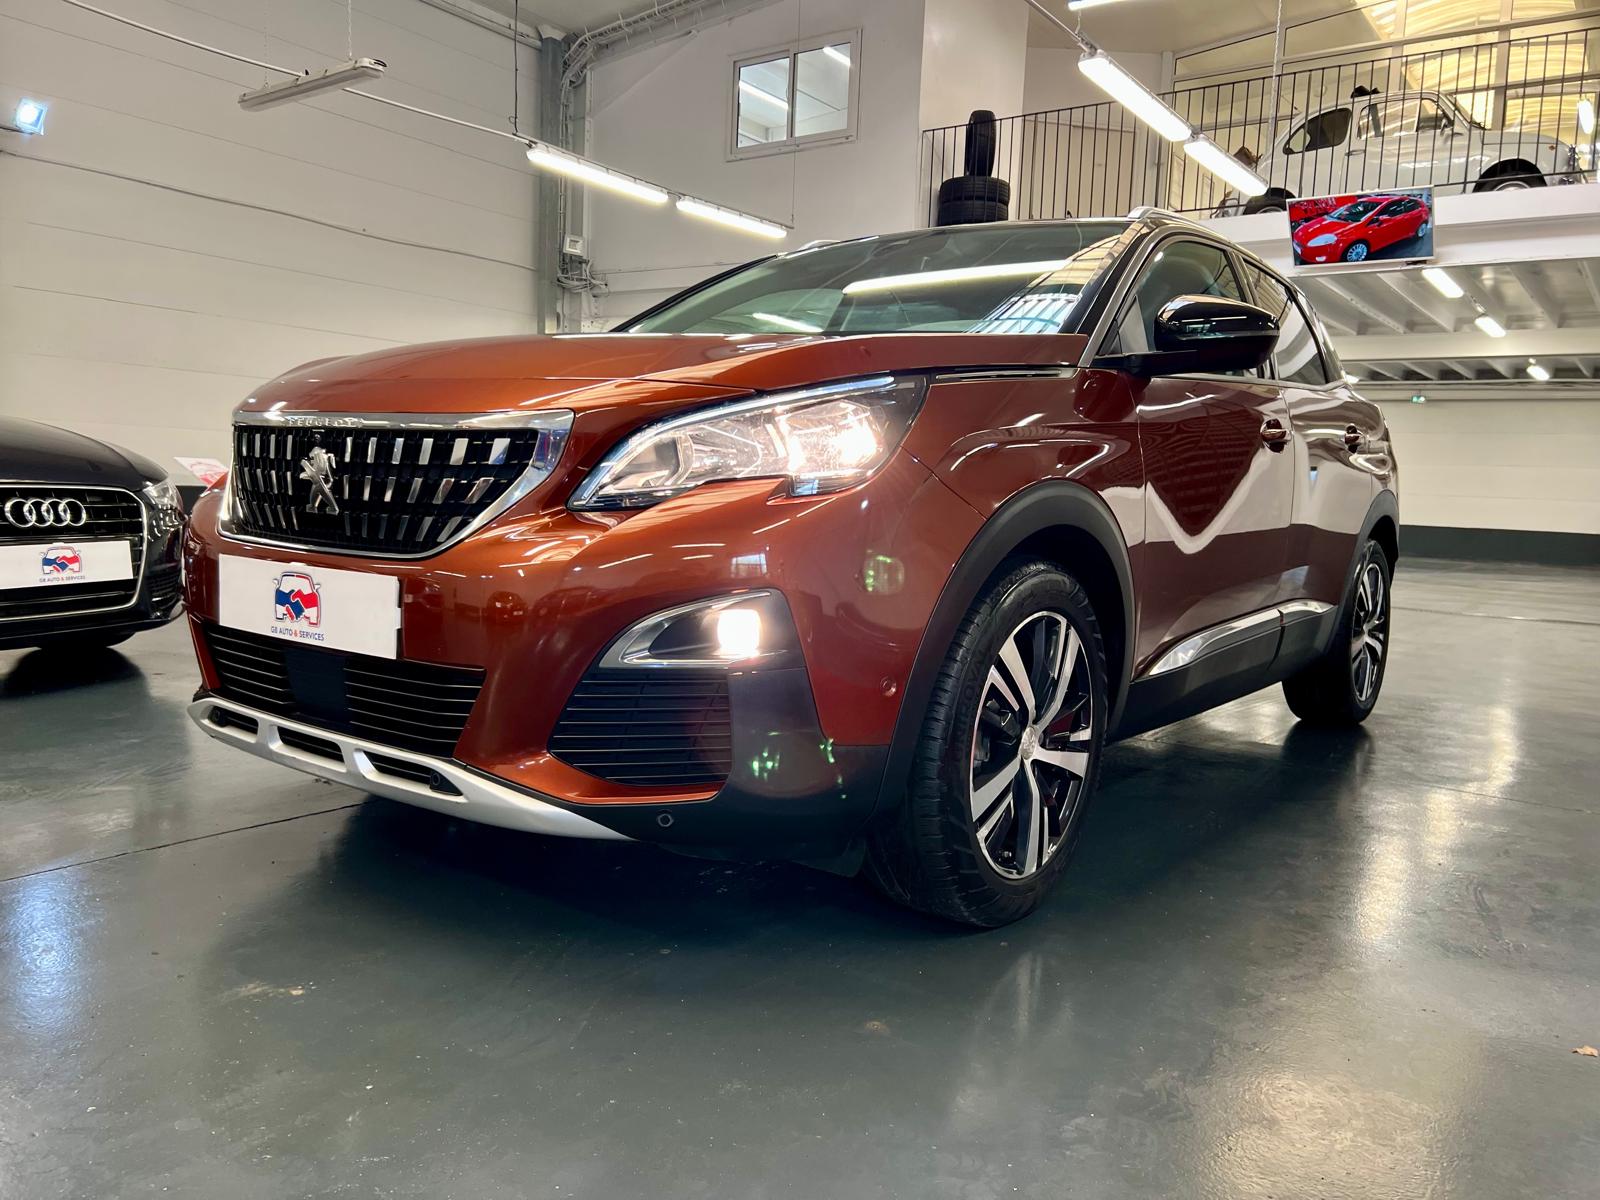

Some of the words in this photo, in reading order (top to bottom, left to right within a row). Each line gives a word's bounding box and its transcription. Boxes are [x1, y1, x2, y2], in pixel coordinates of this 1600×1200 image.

[288, 416, 357, 427] PEUGEOT
[279, 627, 293, 636] AUTO
[293, 629, 298, 637] &
[299, 630, 325, 641] SERVICES
